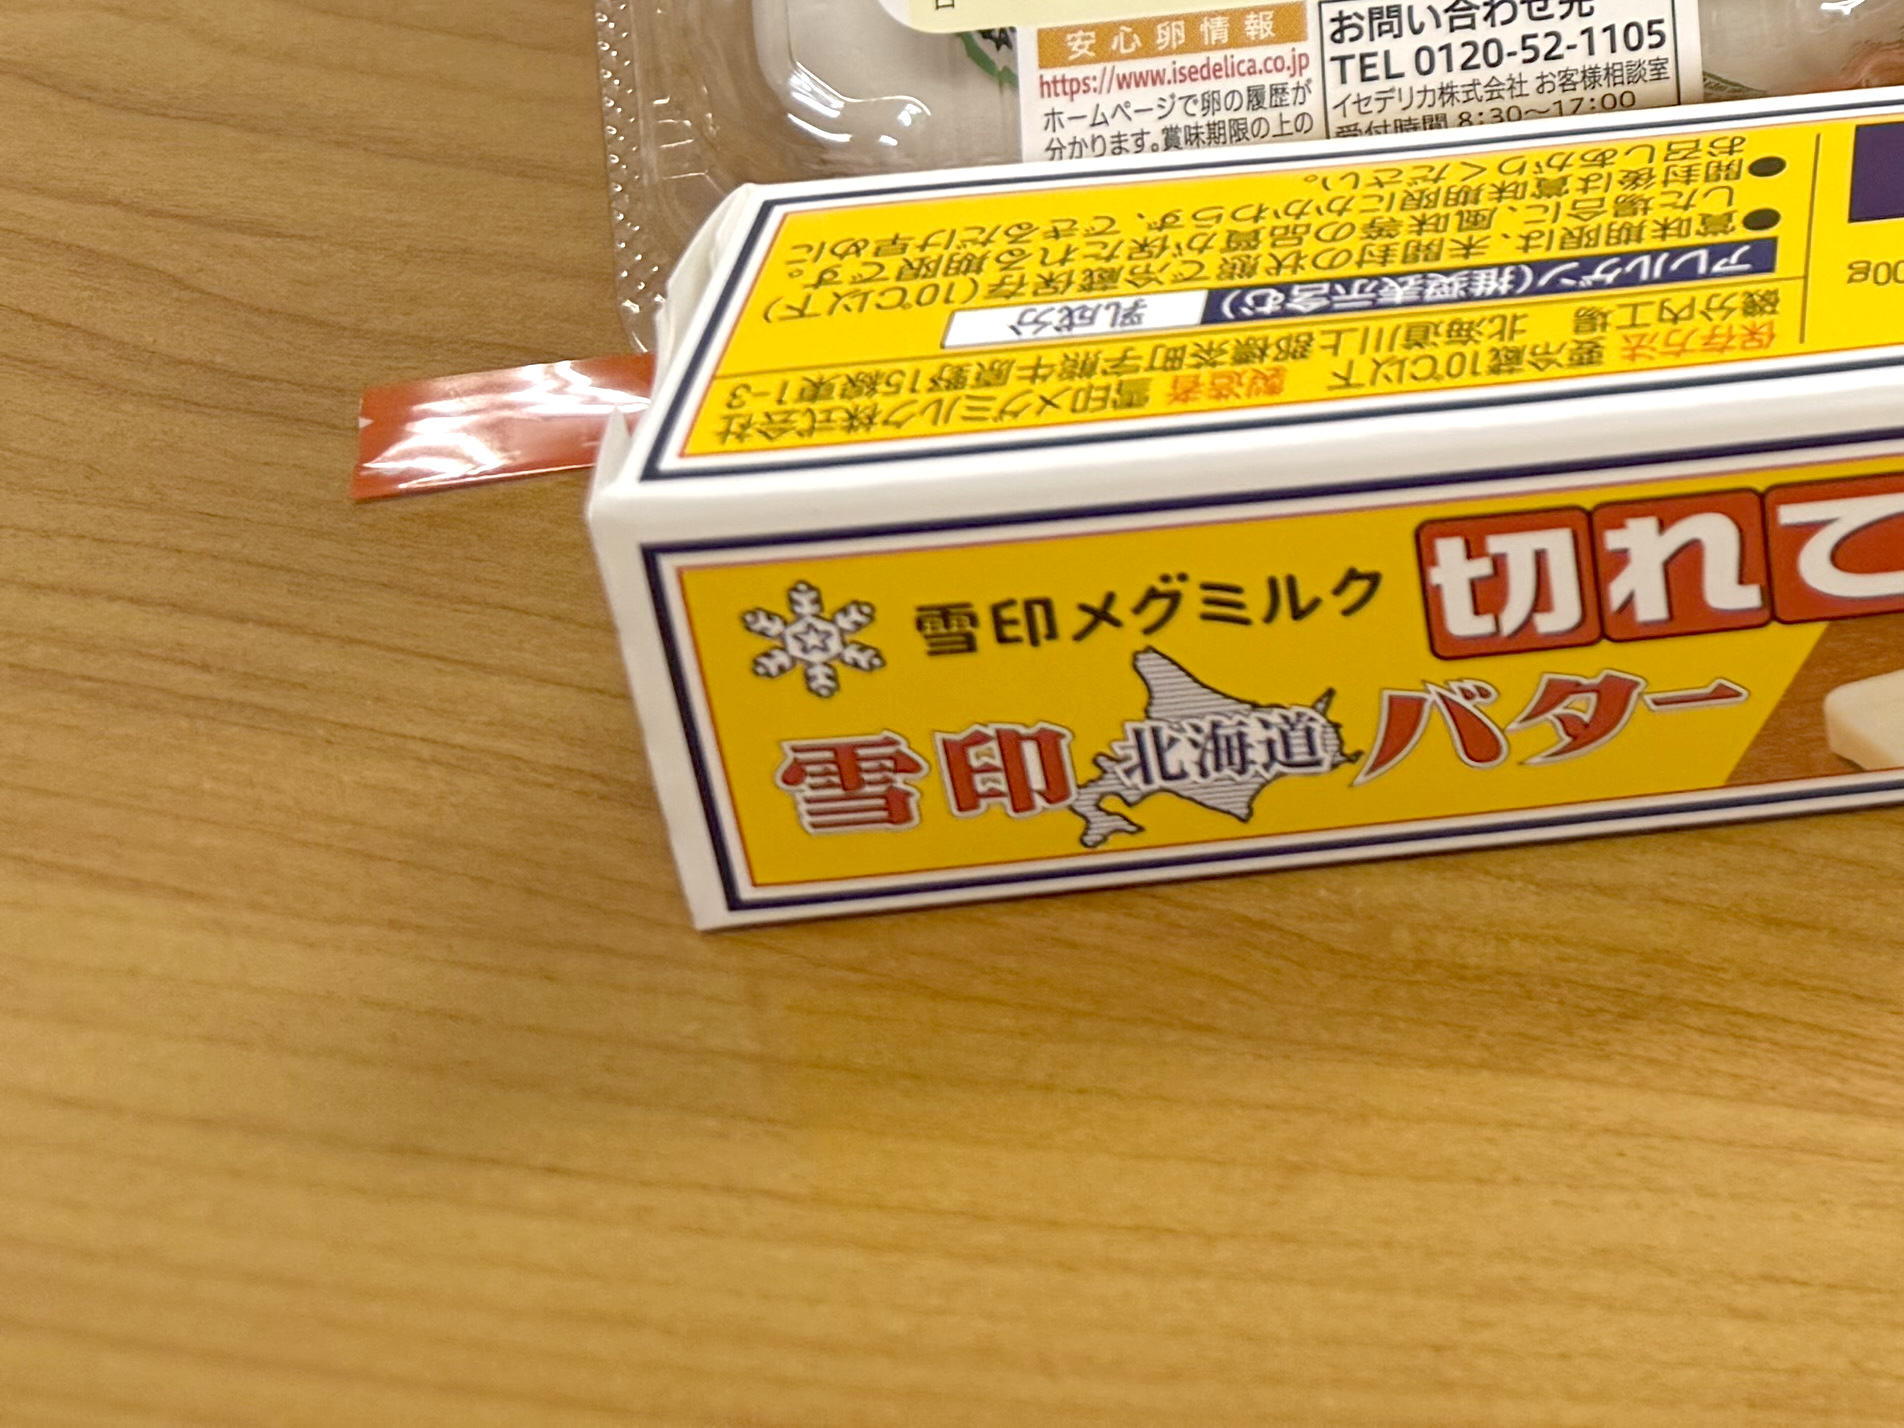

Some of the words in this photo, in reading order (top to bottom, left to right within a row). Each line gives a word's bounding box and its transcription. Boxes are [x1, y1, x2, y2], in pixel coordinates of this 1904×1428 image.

[1066, 11, 1277, 58] 安心卵情報
[1331, 52, 1405, 85] TEL
[1415, 18, 1668, 76] 0120-52-1105
[1040, 51, 1311, 101] https://www.isedelica.co.jp
[1330, 75, 1529, 119] イセデリカ株式会社
[1535, 56, 1671, 96] お客様相談室
[1043, 79, 1313, 132] ホームページで卵の履歴が
[1046, 112, 1314, 162] 分かります。賞味期限の上の
[1299, 134, 1745, 194] お召しあがりください。
[1006, 297, 1149, 337] 乳成分
[1572, 287, 1779, 335] 磯分内工場
[1621, 318, 1775, 363] 保存方法
[709, 373, 1156, 447] 雪印メグミルク株式会社
[1163, 366, 1286, 406] 製造者
[915, 566, 1384, 657] 雪印メグミルク
[777, 722, 1079, 836] 雪印
[1121, 708, 1334, 791] 北海道
[1352, 668, 1752, 787] バター
